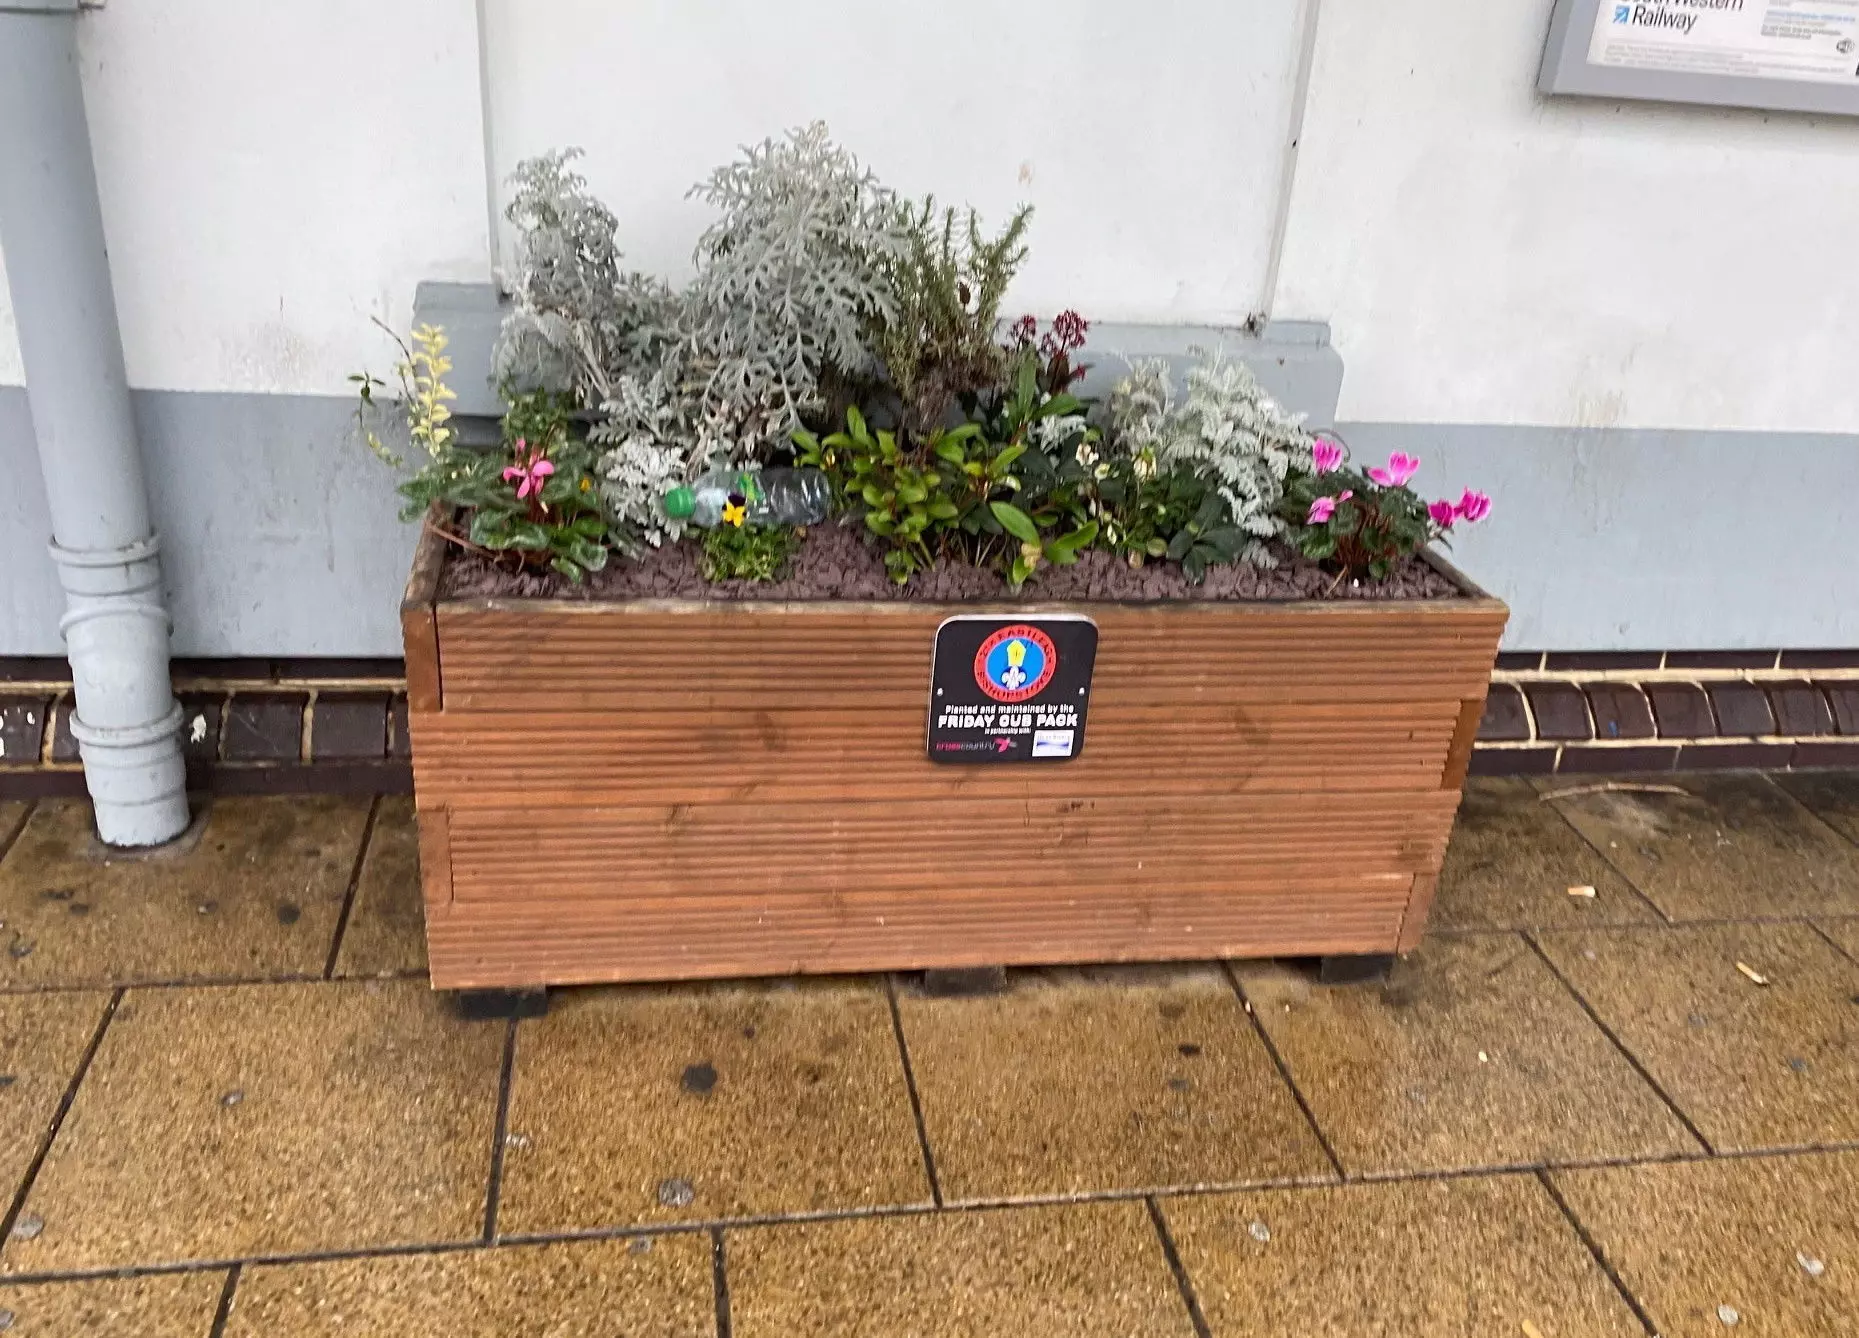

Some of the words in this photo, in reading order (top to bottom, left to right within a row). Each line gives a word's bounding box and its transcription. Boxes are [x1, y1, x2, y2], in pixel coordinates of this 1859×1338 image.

[1632, 4, 1698, 35] Railway
[945, 704, 978, 714] Planted
[980, 704, 996, 714] and
[998, 704, 1045, 714] maintained
[1047, 704, 1058, 715] by
[1059, 703, 1074, 713] the
[938, 714, 995, 728] FRIDAY
[999, 713, 1032, 727] CUB
[1036, 713, 1078, 727] PACK
